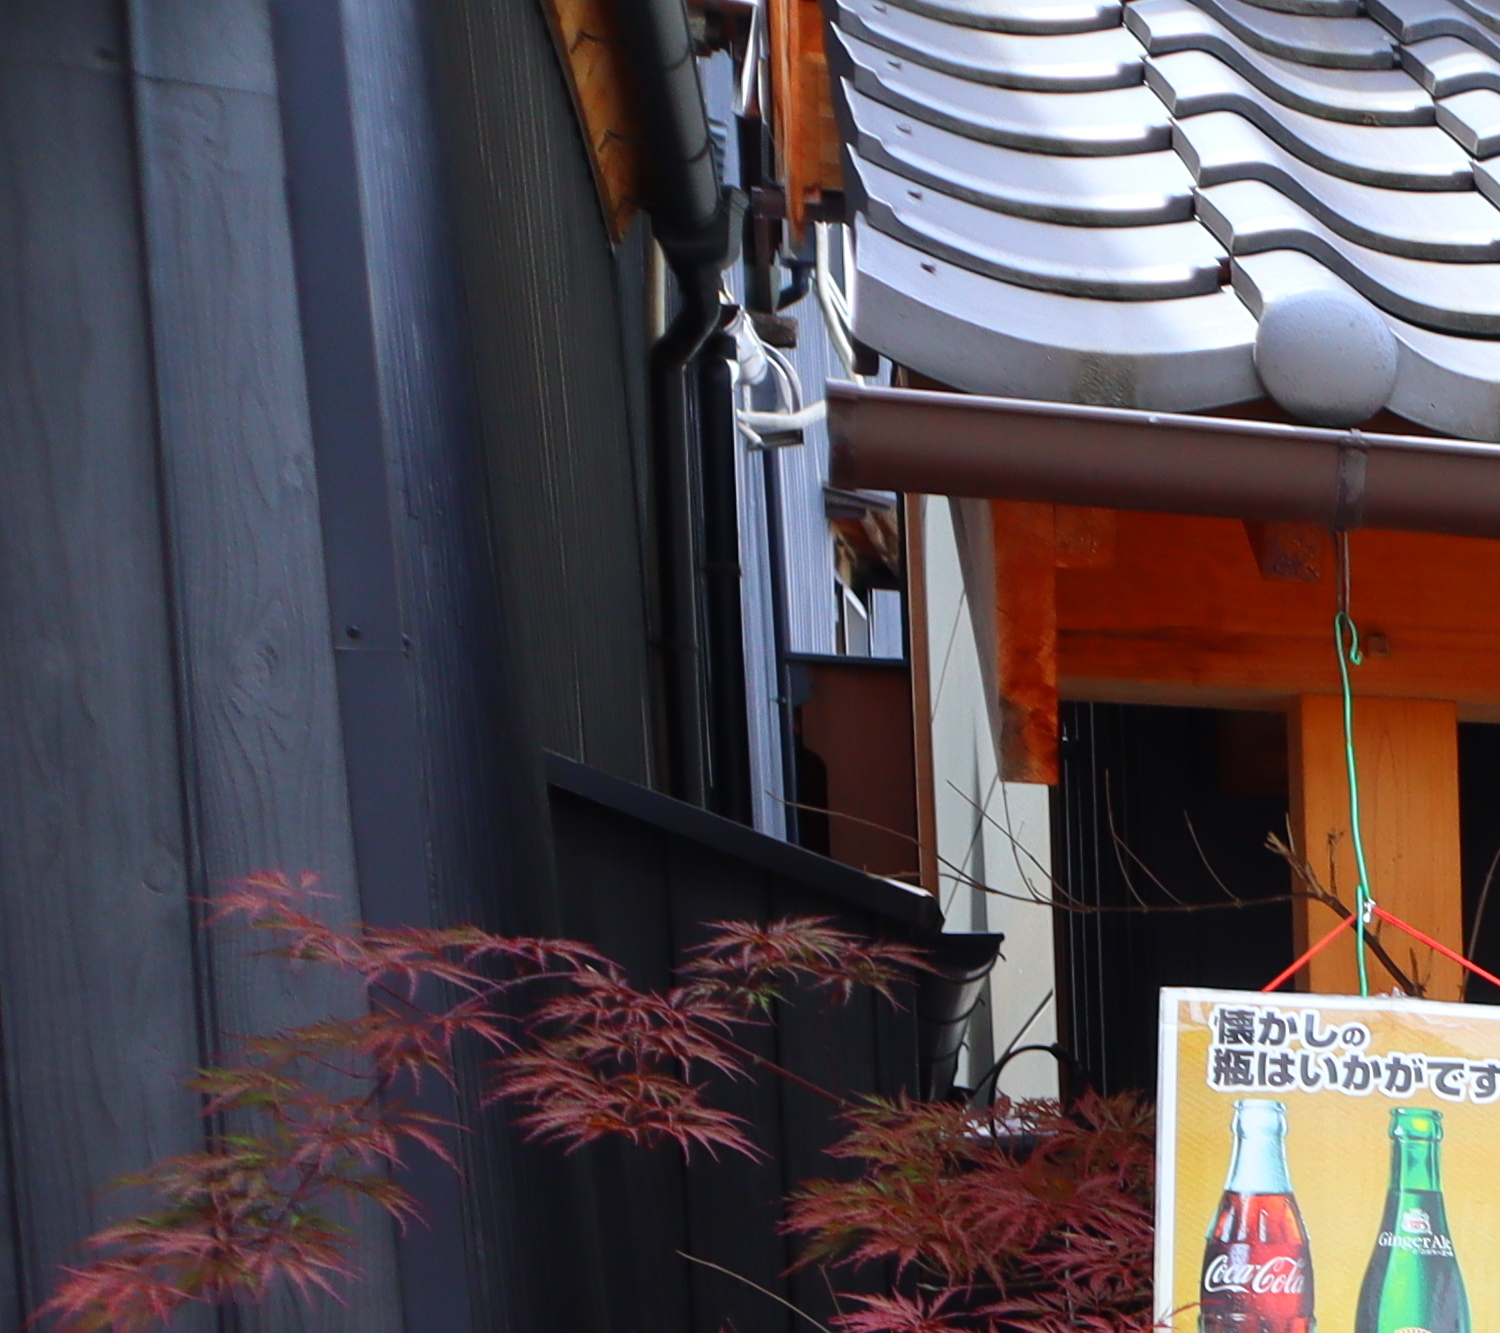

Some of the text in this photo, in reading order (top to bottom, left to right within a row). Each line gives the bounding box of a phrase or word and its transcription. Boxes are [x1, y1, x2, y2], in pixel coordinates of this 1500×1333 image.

[1215, 1008, 1366, 1046] 懐かしの
[1204, 1254, 1304, 1294] Coca-Cola
